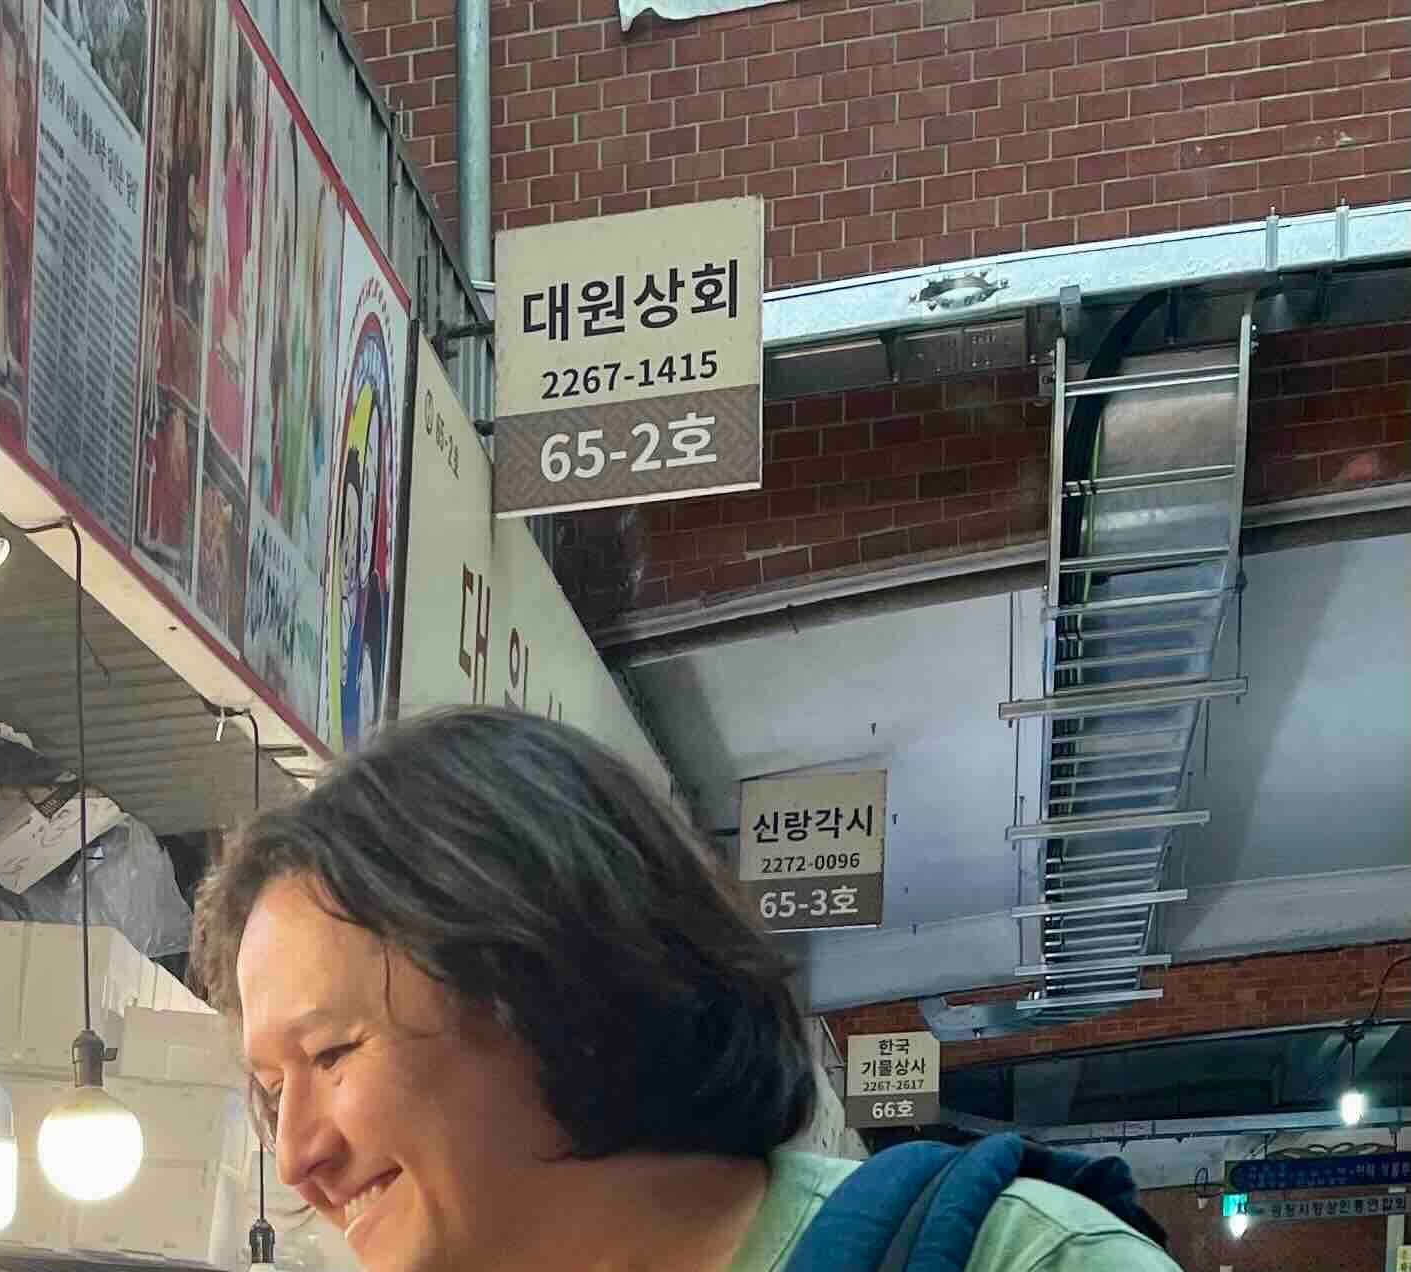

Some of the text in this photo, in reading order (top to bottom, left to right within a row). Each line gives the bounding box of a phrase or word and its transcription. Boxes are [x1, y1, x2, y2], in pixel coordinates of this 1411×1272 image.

[522, 259, 739, 341] 대원상회
[541, 350, 718, 399] 2267-1415
[540, 411, 717, 482] 65-2호
[753, 804, 873, 843] 신랑각시
[762, 852, 860, 873] 2272-0096
[760, 885, 858, 919] 65-3호
[878, 1038, 909, 1056] 한국
[861, 1057, 926, 1077] 기물상사
[872, 1099, 914, 1119] 66호
